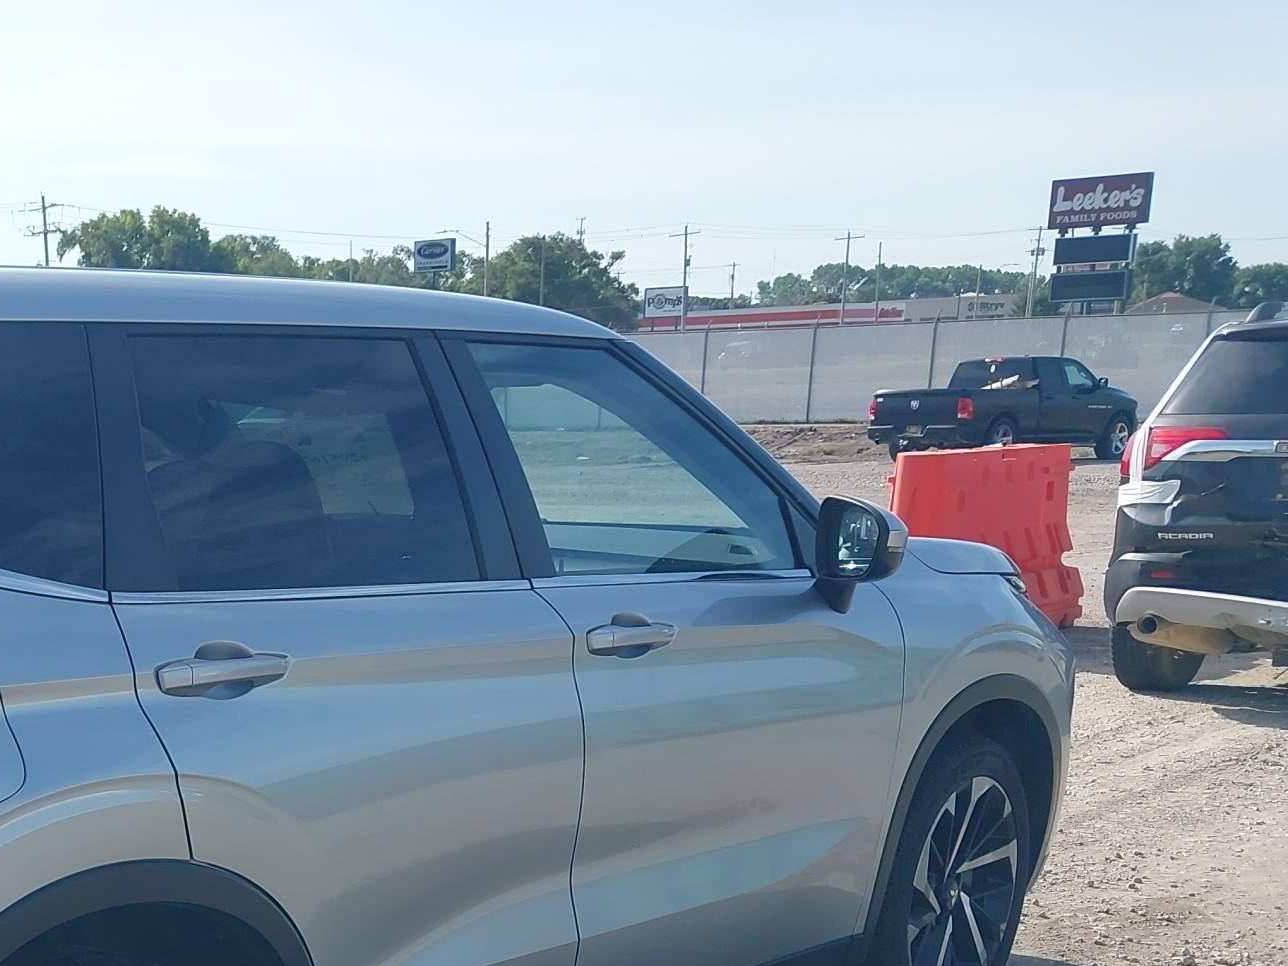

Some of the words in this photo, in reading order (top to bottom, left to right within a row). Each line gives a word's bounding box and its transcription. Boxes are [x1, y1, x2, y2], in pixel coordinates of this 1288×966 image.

[1053, 183, 1145, 212] Leeker's
[1056, 213, 1096, 224] FAMILY
[1099, 210, 1137, 221] FOODS
[1158, 532, 1214, 540] ACADIA
